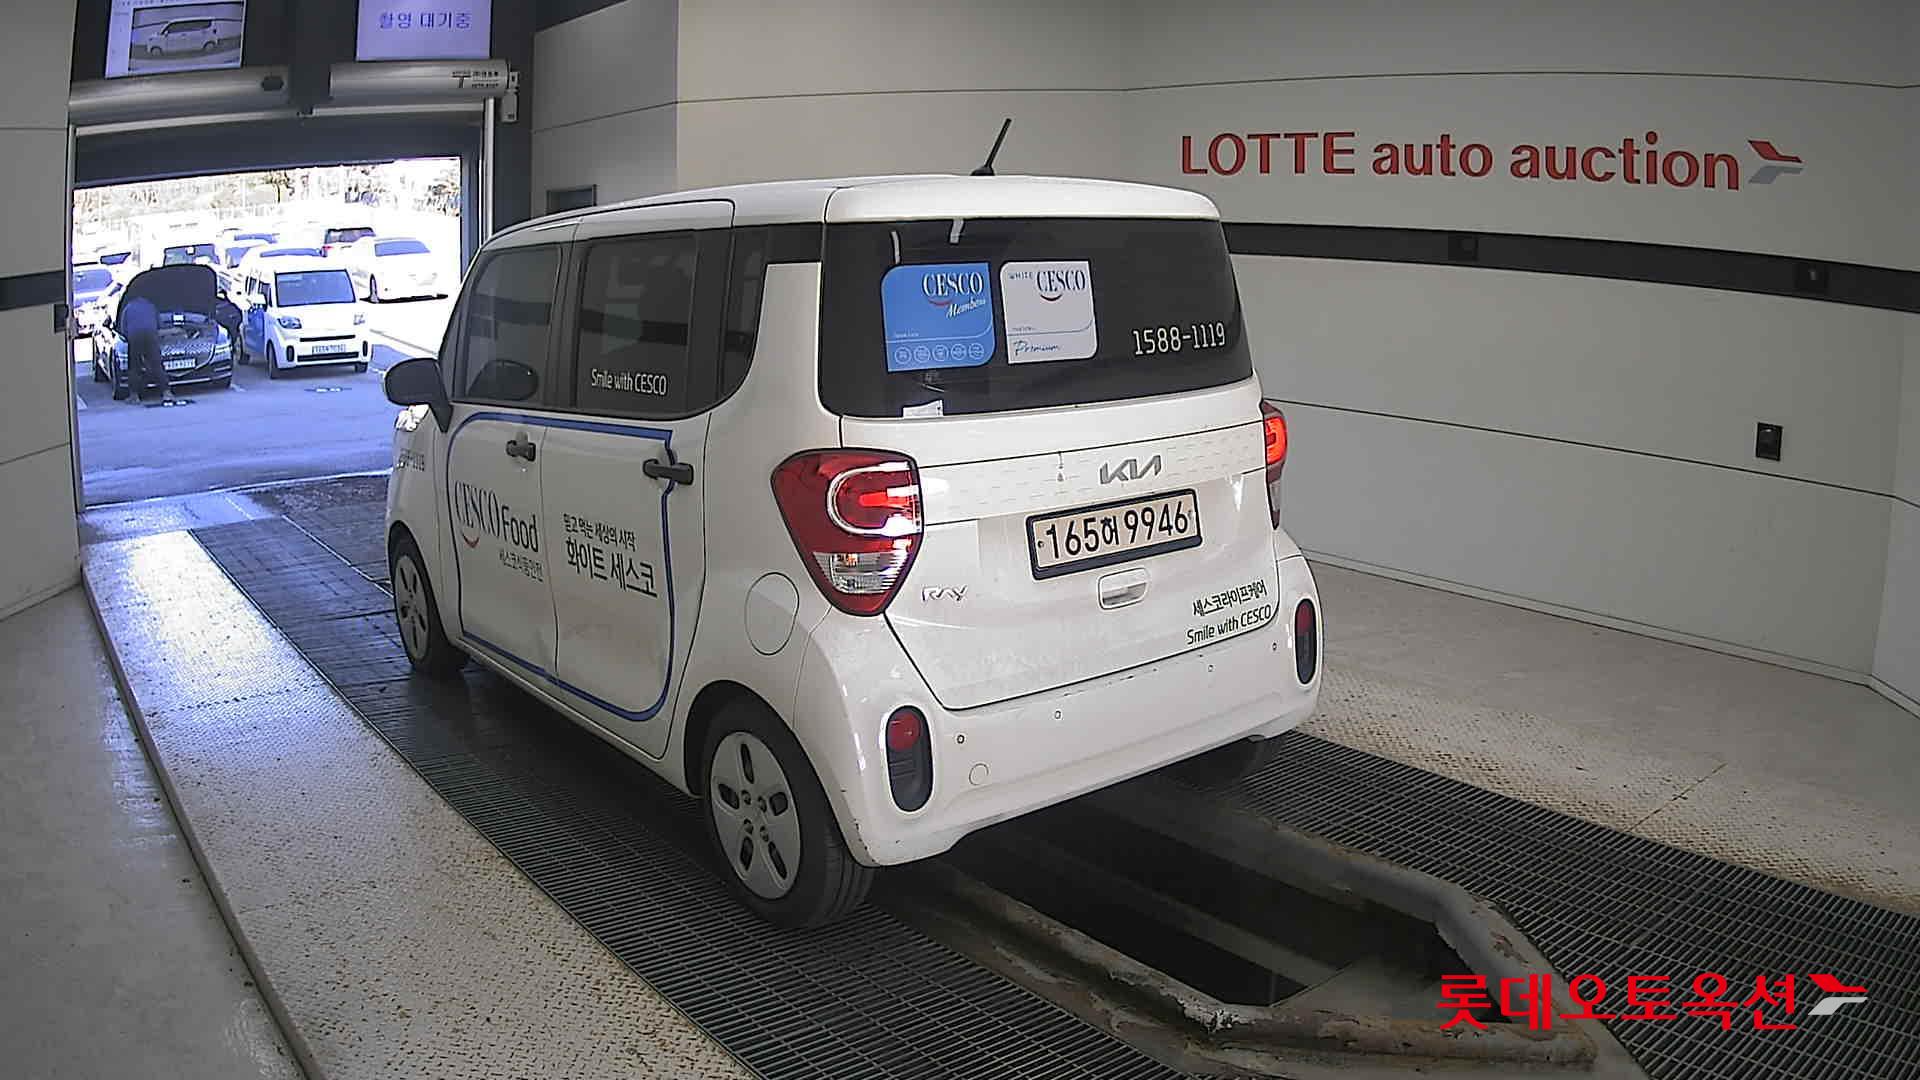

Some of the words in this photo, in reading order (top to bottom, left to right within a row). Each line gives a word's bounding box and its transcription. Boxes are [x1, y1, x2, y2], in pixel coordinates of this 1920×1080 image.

[420, 11, 472, 29] 대기중
[1181, 131, 1356, 176] LOTTE
[1371, 134, 1494, 178] auto
[1509, 131, 1740, 191] auction
[923, 272, 984, 297] CESCO
[1036, 269, 1086, 293] CESCO
[1132, 322, 1226, 356] 1588-1119
[591, 368, 612, 389] Smile
[613, 371, 633, 392] with
[634, 373, 667, 396] CESCO
[1100, 454, 1162, 485] KIA
[455, 481, 501, 538] CESCO
[502, 506, 538, 552] Food
[1045, 516, 1120, 559] 165허
[1126, 501, 1190, 544] 9946
[595, 523, 618, 547] 세상의
[619, 530, 636, 552] 시작
[565, 536, 608, 580] 화이트
[611, 552, 657, 598] 세스코
[921, 584, 968, 602] RAY
[1192, 579, 1267, 616] 세스코라이프케어
[1186, 624, 1215, 645] Smile
[1217, 616, 1239, 635] with
[1240, 604, 1271, 627] CESCO
